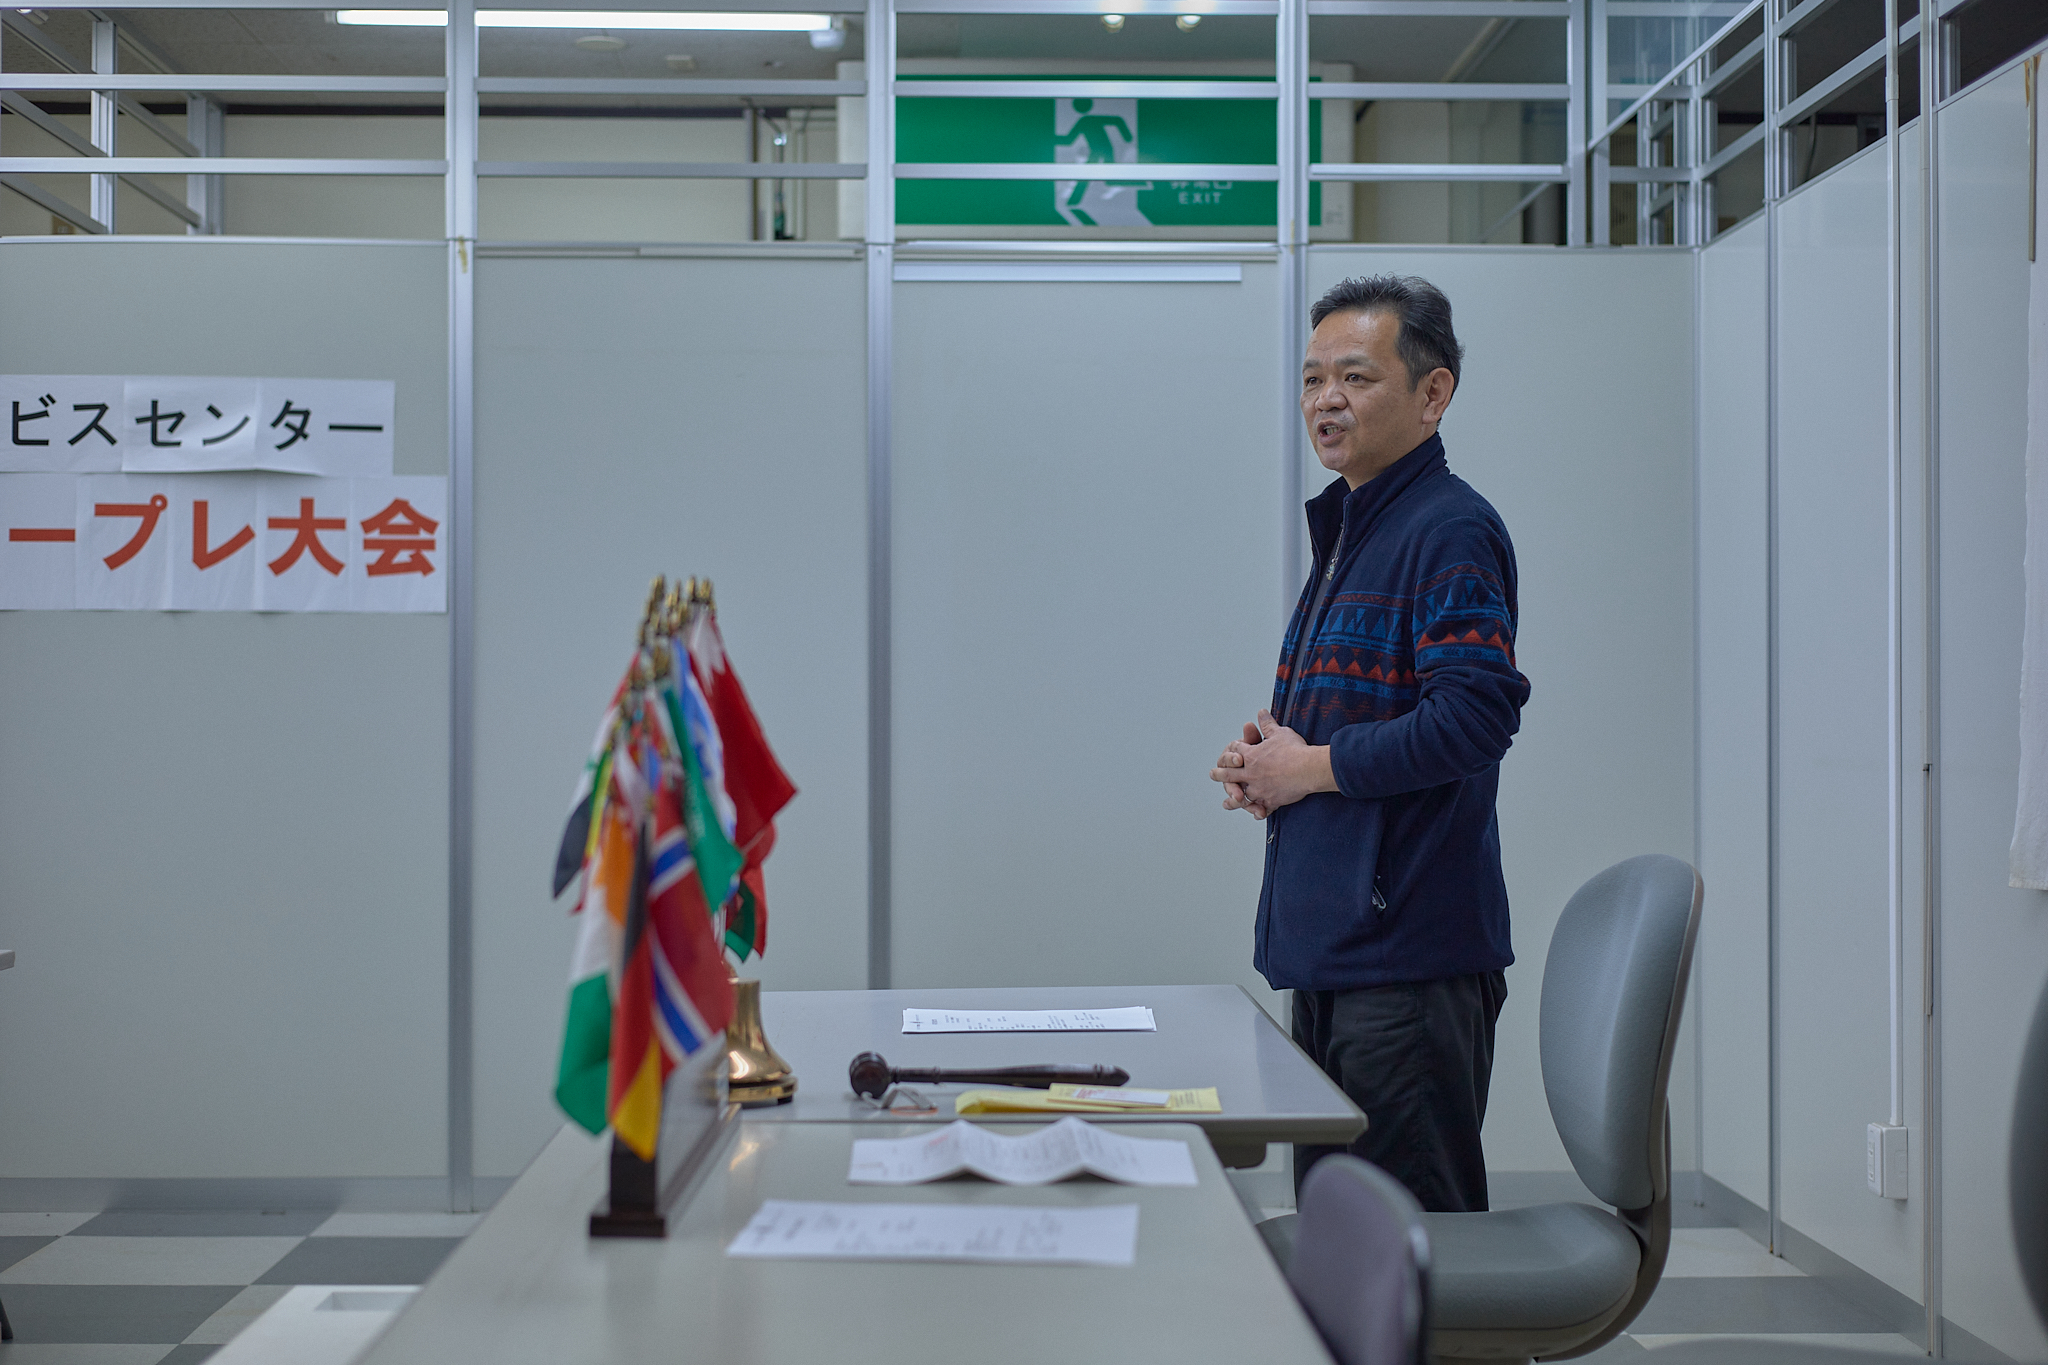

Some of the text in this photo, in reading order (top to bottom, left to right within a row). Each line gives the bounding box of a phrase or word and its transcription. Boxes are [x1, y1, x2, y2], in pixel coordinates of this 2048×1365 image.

[1178, 191, 1221, 205] EXIT
[11, 393, 384, 451] ビスセンター
[8, 493, 440, 577] ープレ大会
